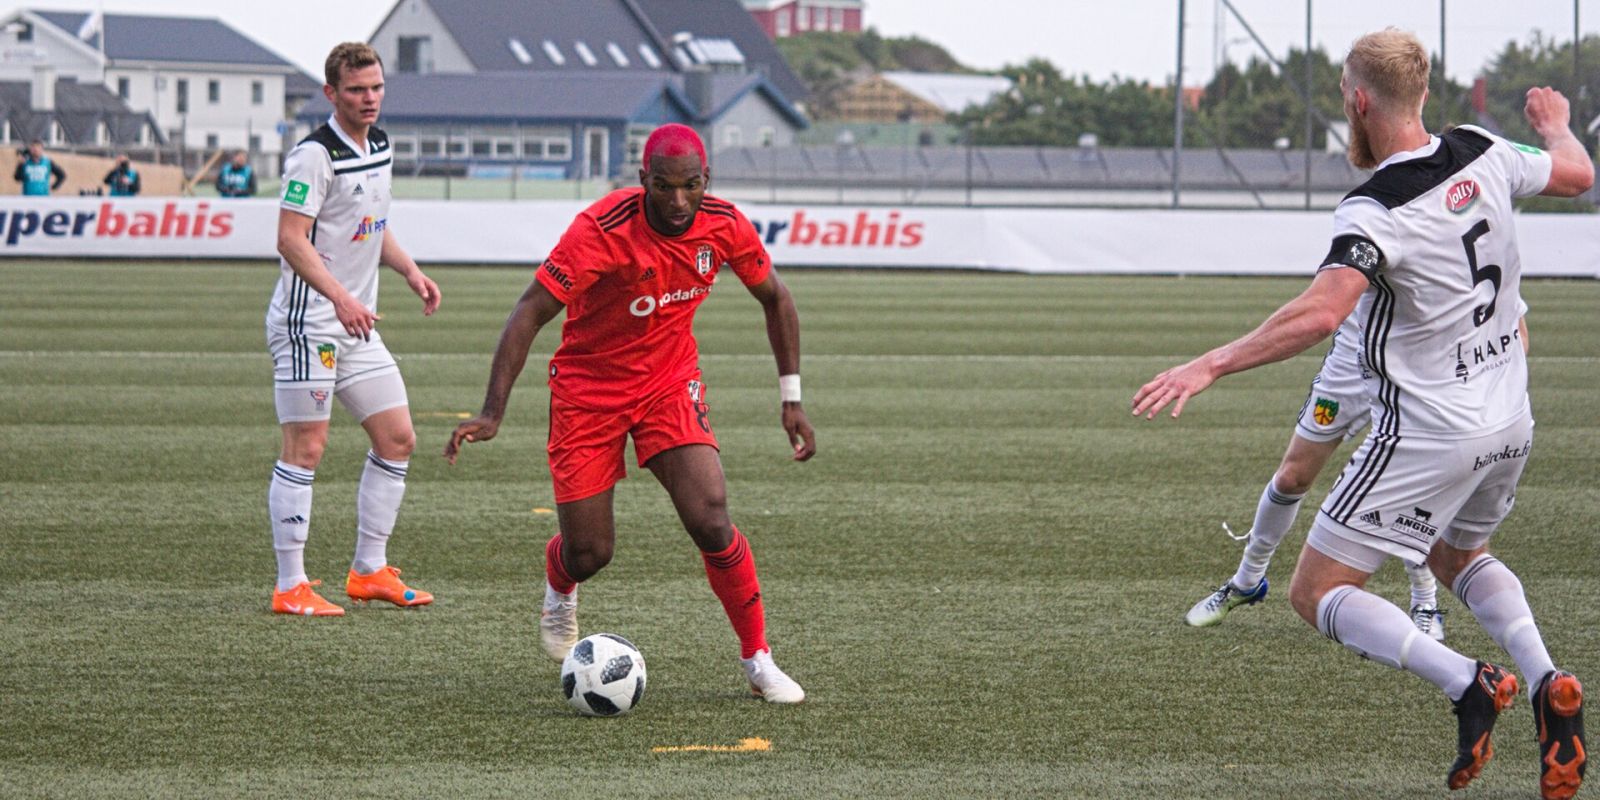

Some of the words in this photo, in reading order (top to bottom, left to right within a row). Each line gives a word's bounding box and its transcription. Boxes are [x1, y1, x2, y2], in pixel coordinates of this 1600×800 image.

[0, 202, 234, 246] perbahis
[1461, 218, 1502, 327] 5
[1394, 516, 1437, 537] ANGUS
